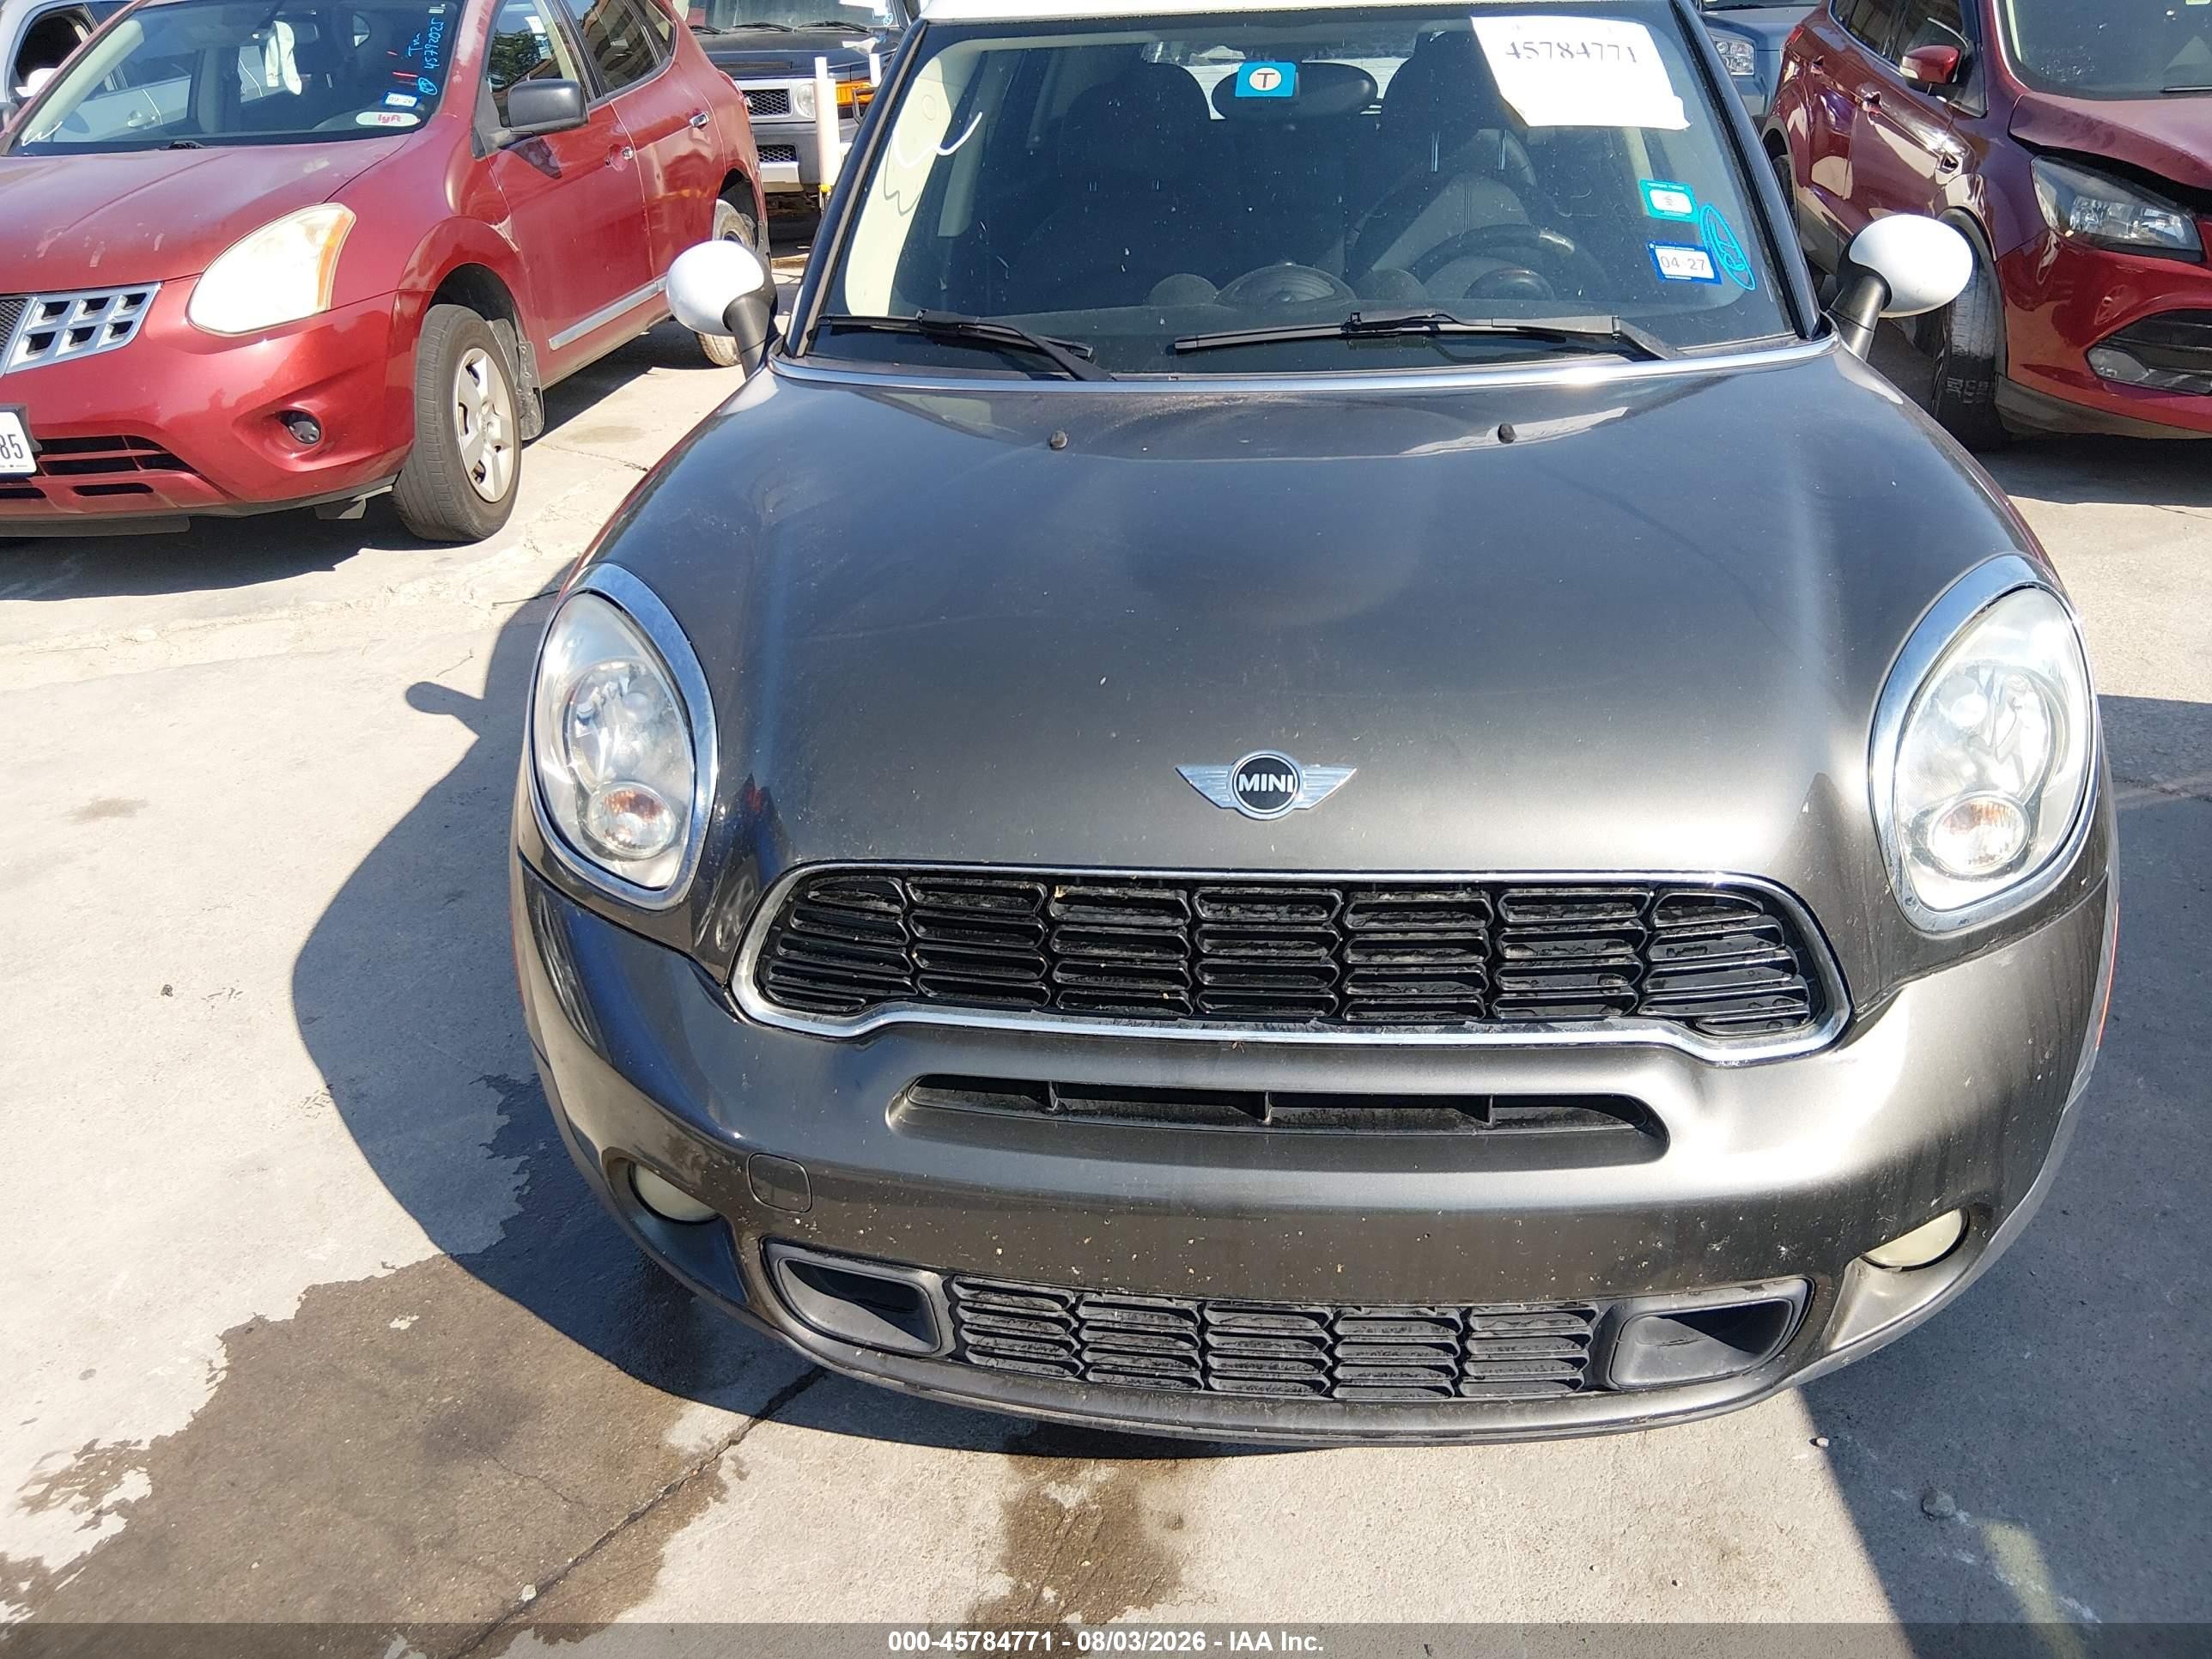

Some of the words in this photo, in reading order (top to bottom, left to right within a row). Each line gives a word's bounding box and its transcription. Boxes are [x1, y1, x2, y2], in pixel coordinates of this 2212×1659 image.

[1505, 41, 1637, 63] 45784771
[1256, 72, 1276, 88] T
[378, 114, 402, 124] lyft
[1238, 773, 1294, 793] MINI
